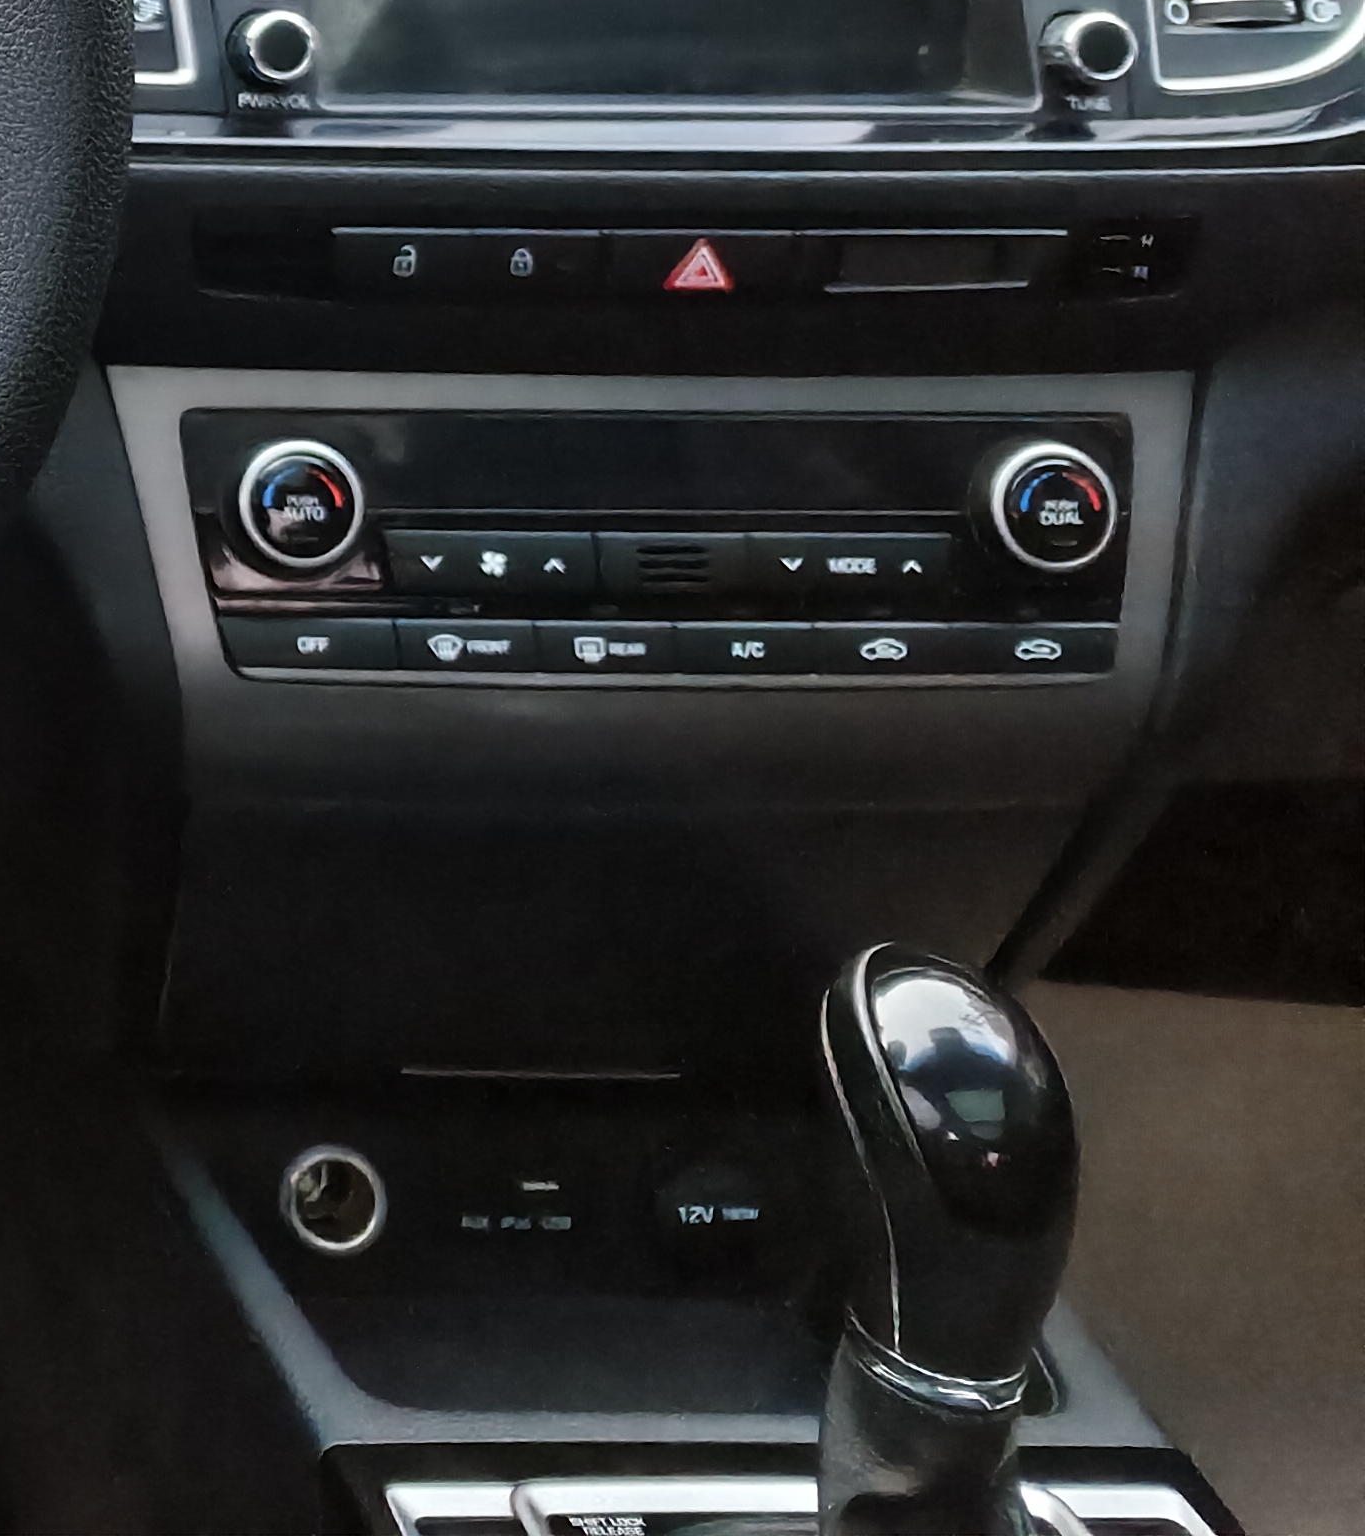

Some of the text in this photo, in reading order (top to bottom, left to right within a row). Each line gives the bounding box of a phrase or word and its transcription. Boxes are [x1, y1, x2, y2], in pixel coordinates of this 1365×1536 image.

[283, 505, 325, 522] AUTO
[731, 641, 766, 659] A/C
[678, 1205, 714, 1224] 12V
